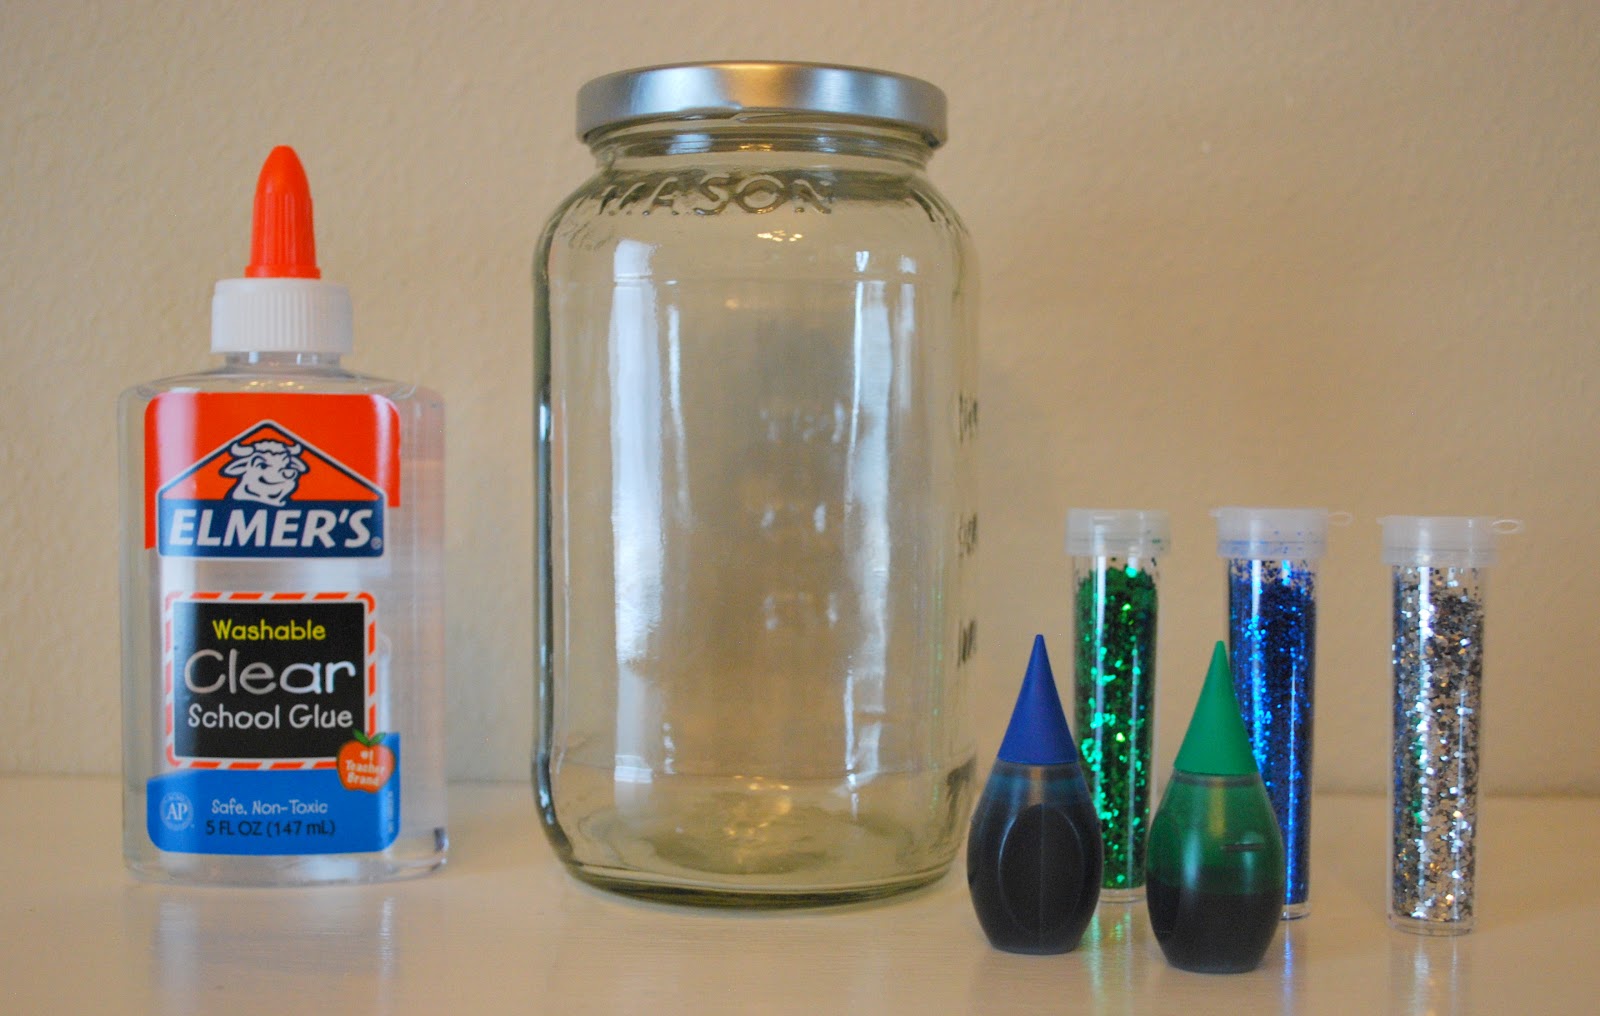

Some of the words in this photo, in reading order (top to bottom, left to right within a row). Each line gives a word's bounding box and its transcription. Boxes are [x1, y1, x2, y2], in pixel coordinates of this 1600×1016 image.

[168, 509, 373, 548] ELMER'S
[212, 618, 327, 640] Washable
[184, 648, 356, 695] Clear
[187, 703, 280, 729] School
[288, 704, 353, 728] Glue
[347, 771, 379, 787] Brand
[252, 799, 328, 815] Non-Toxic
[205, 820, 215, 835] 5
[219, 820, 235, 836] FL
[238, 820, 263, 836] OZ
[266, 820, 301, 837] (147
[306, 820, 335, 836] mL)
